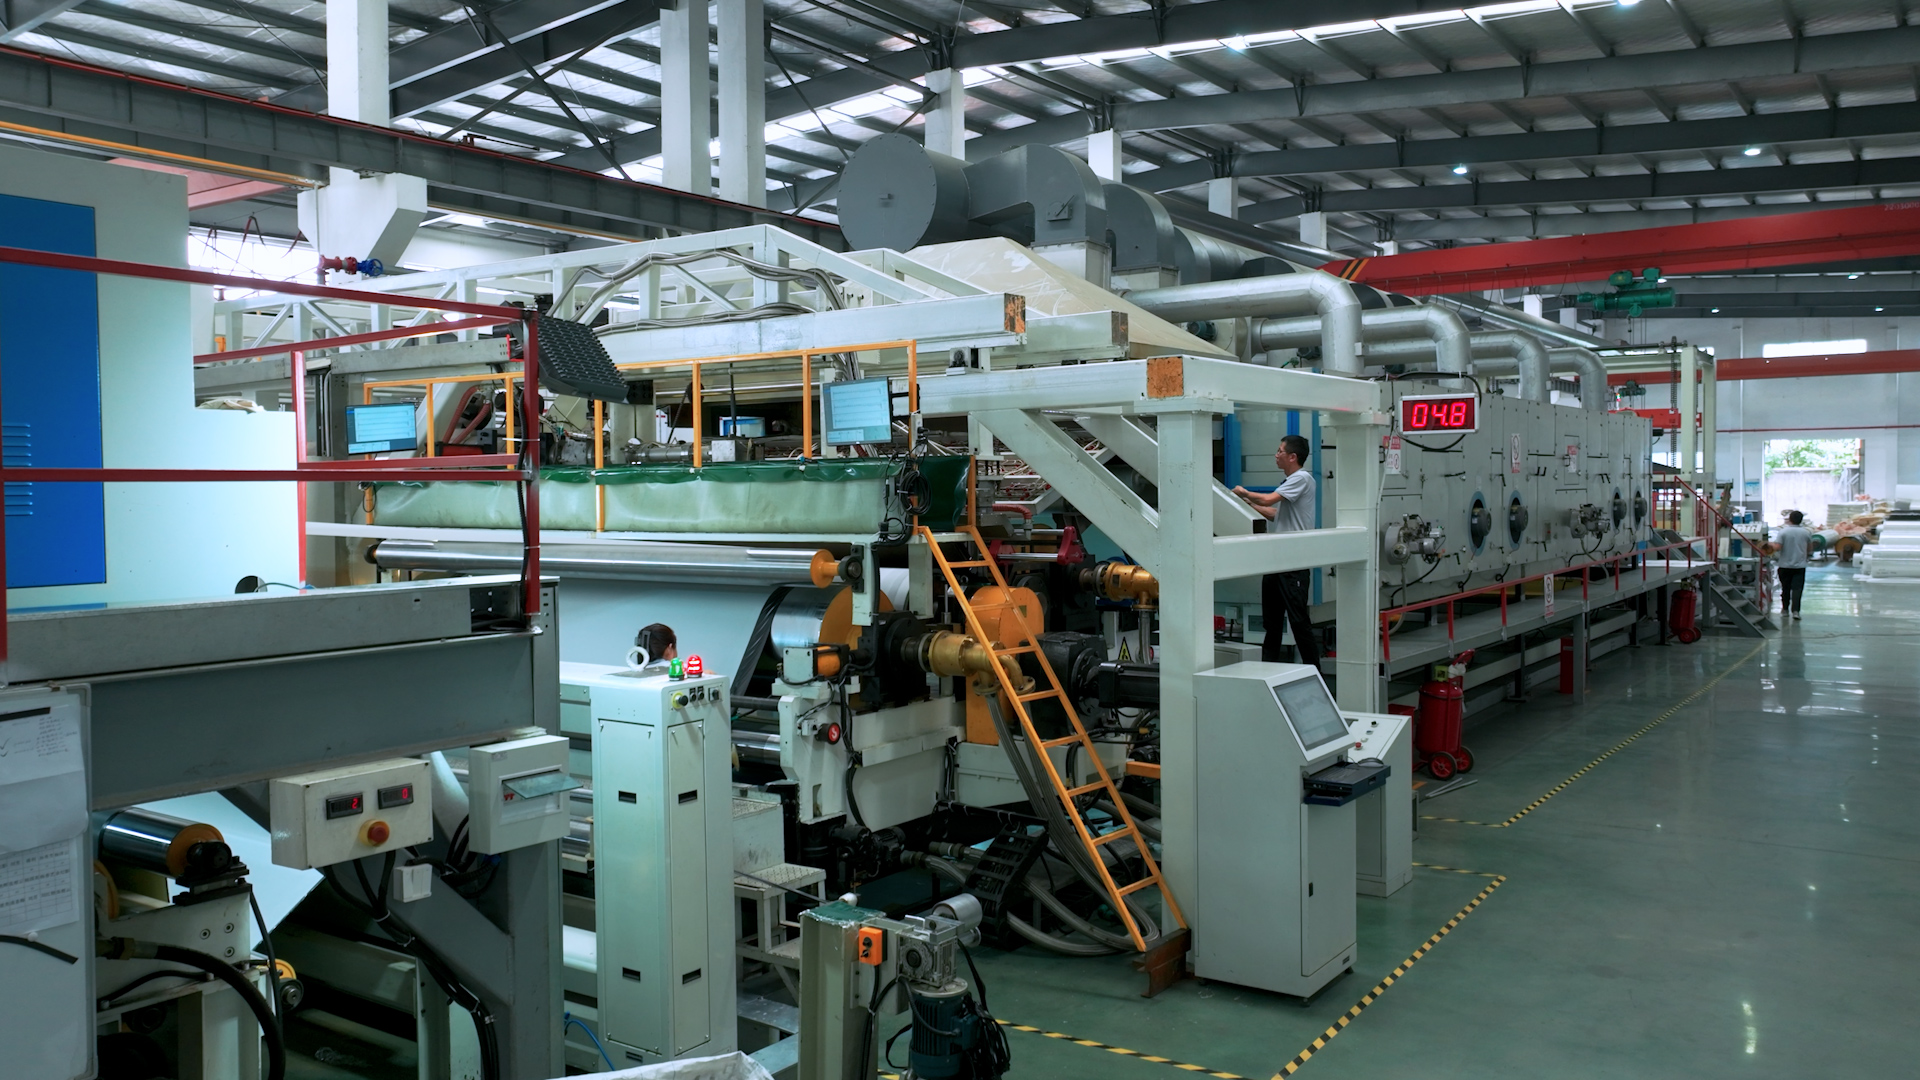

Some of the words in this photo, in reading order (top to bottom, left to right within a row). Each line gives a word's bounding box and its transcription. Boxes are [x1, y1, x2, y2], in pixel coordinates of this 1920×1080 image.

[1412, 402, 1467, 428] 04.8
[402, 788, 408, 799] 0
[352, 797, 358, 809] 2
